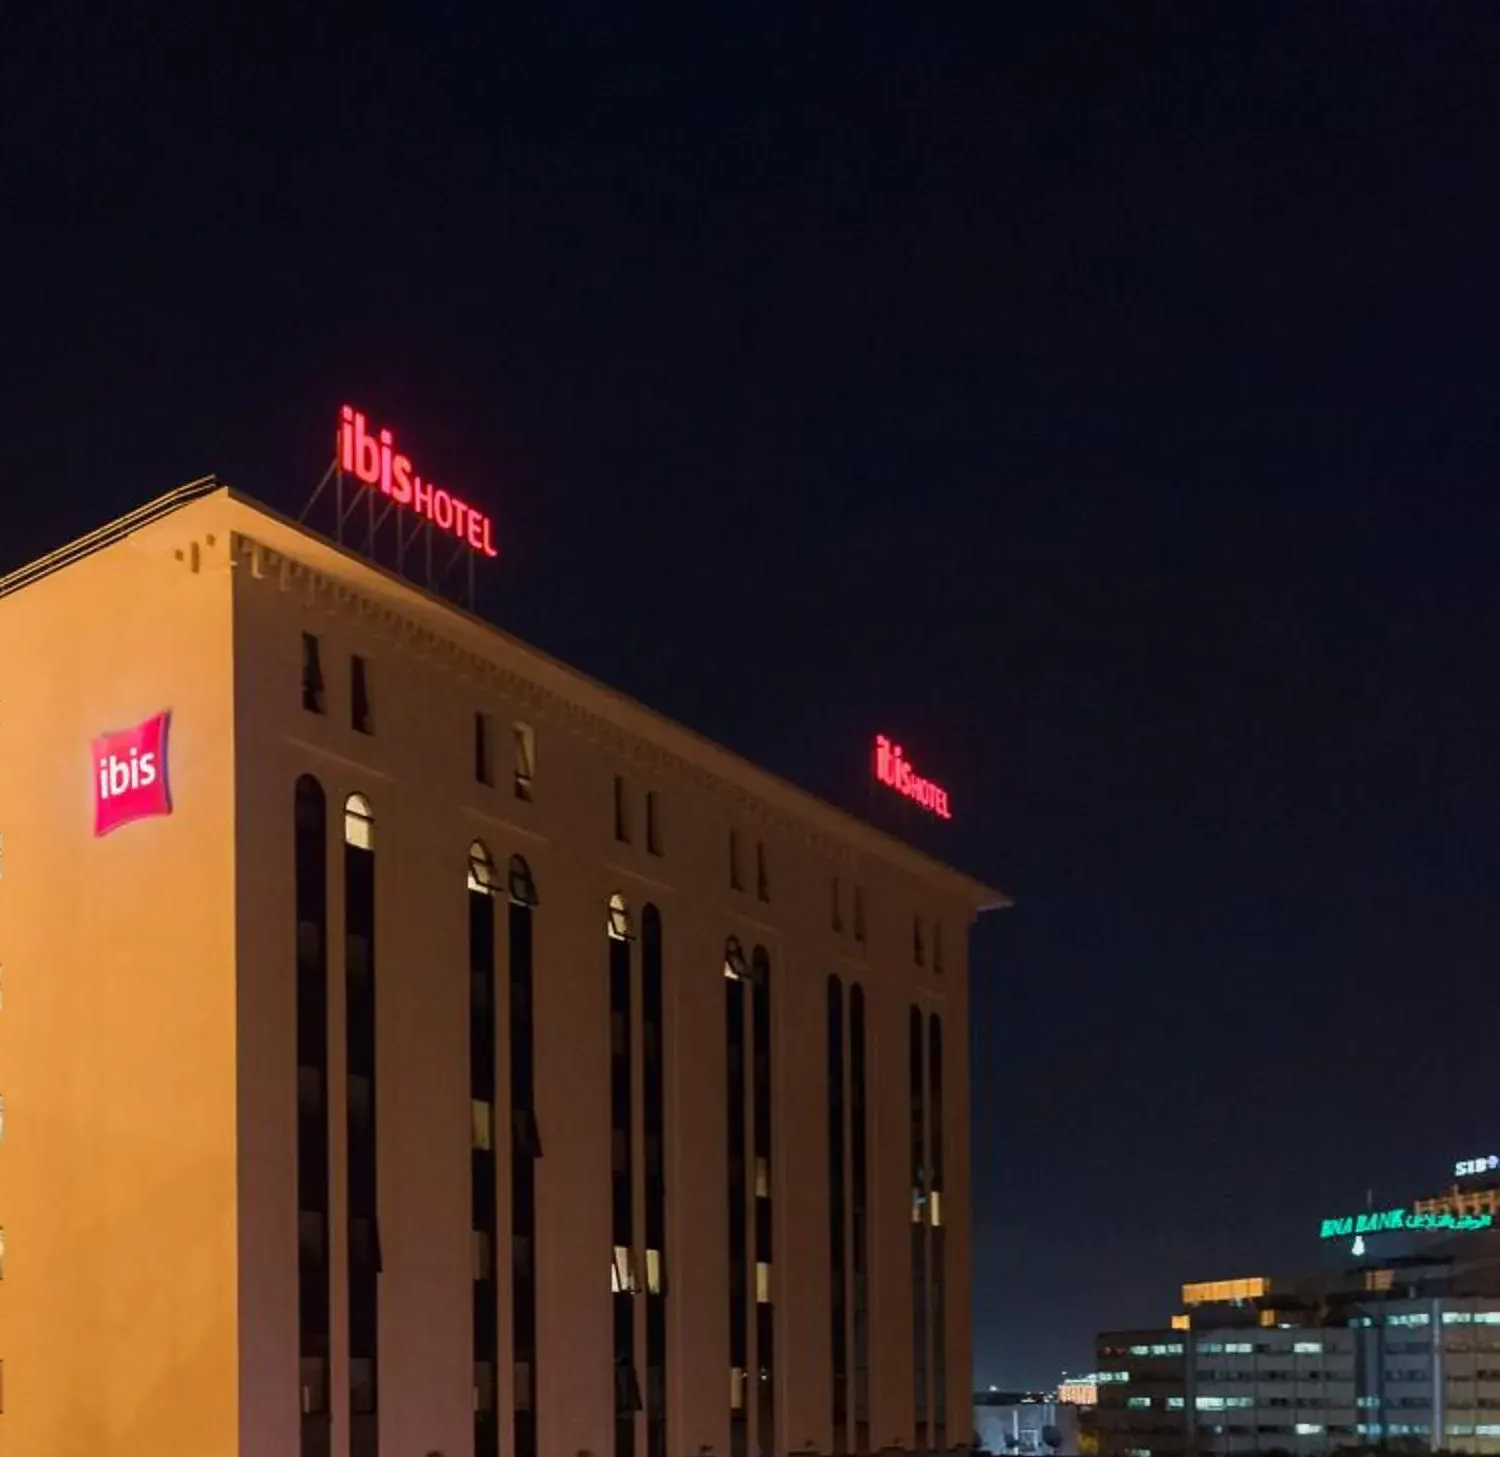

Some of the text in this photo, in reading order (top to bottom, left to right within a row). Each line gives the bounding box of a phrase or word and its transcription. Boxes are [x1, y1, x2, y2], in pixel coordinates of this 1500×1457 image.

[342, 404, 497, 557] ibis HOTEL
[100, 747, 156, 799] ibis
[911, 774, 951, 819] HOTEL
[1355, 1208, 1405, 1232] BANK
